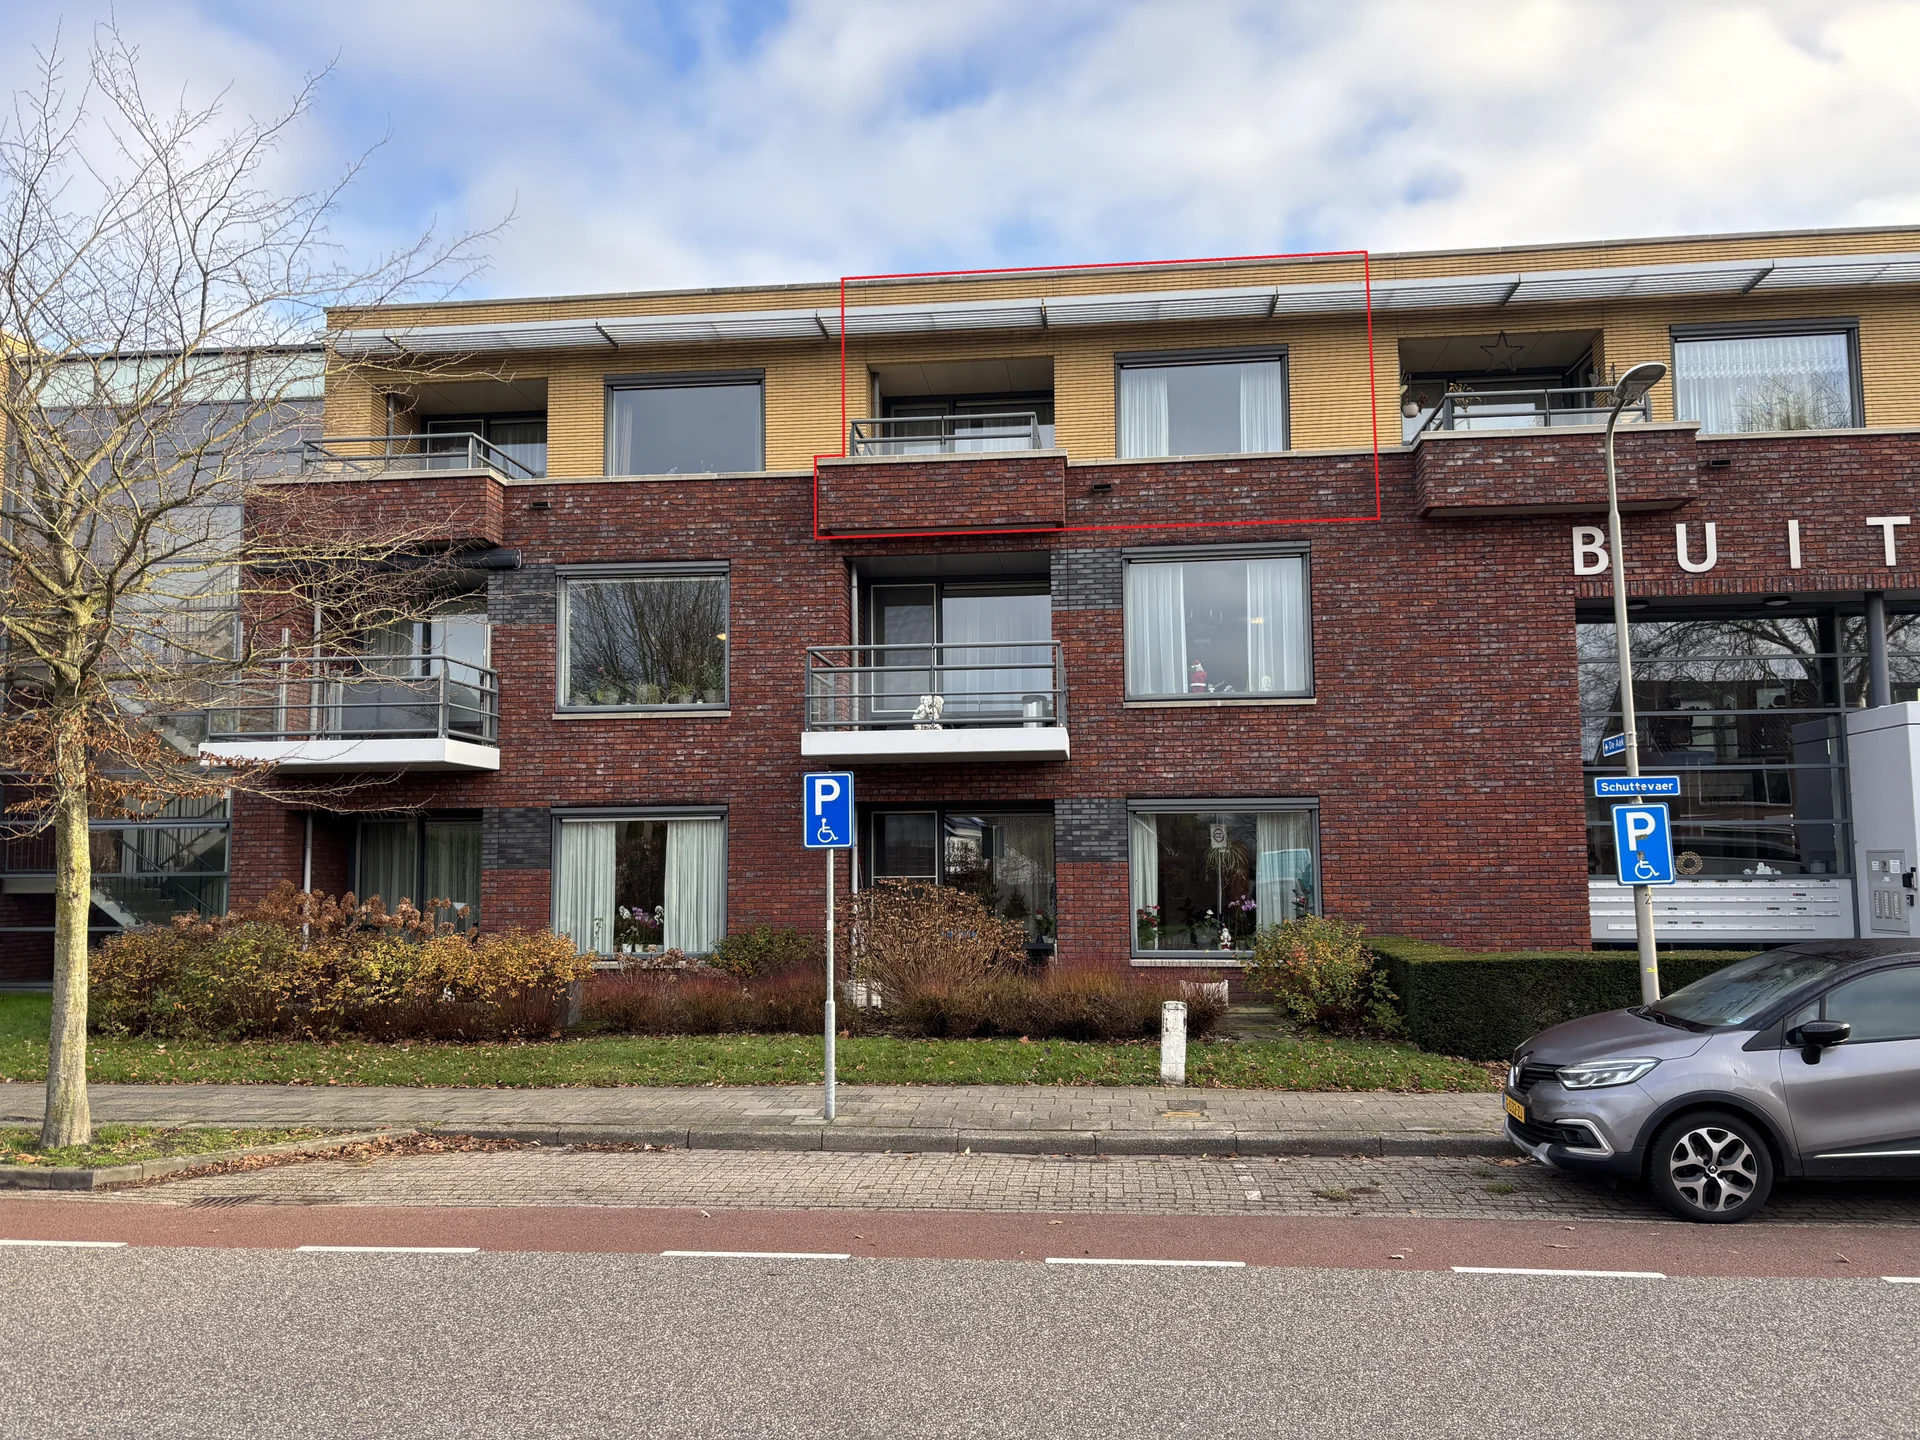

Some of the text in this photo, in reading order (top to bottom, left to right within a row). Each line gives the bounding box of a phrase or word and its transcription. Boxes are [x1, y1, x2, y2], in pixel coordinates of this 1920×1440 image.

[815, 778, 840, 815] P
[1601, 782, 1674, 792] Schuttevaer
[1625, 811, 1656, 851] P
